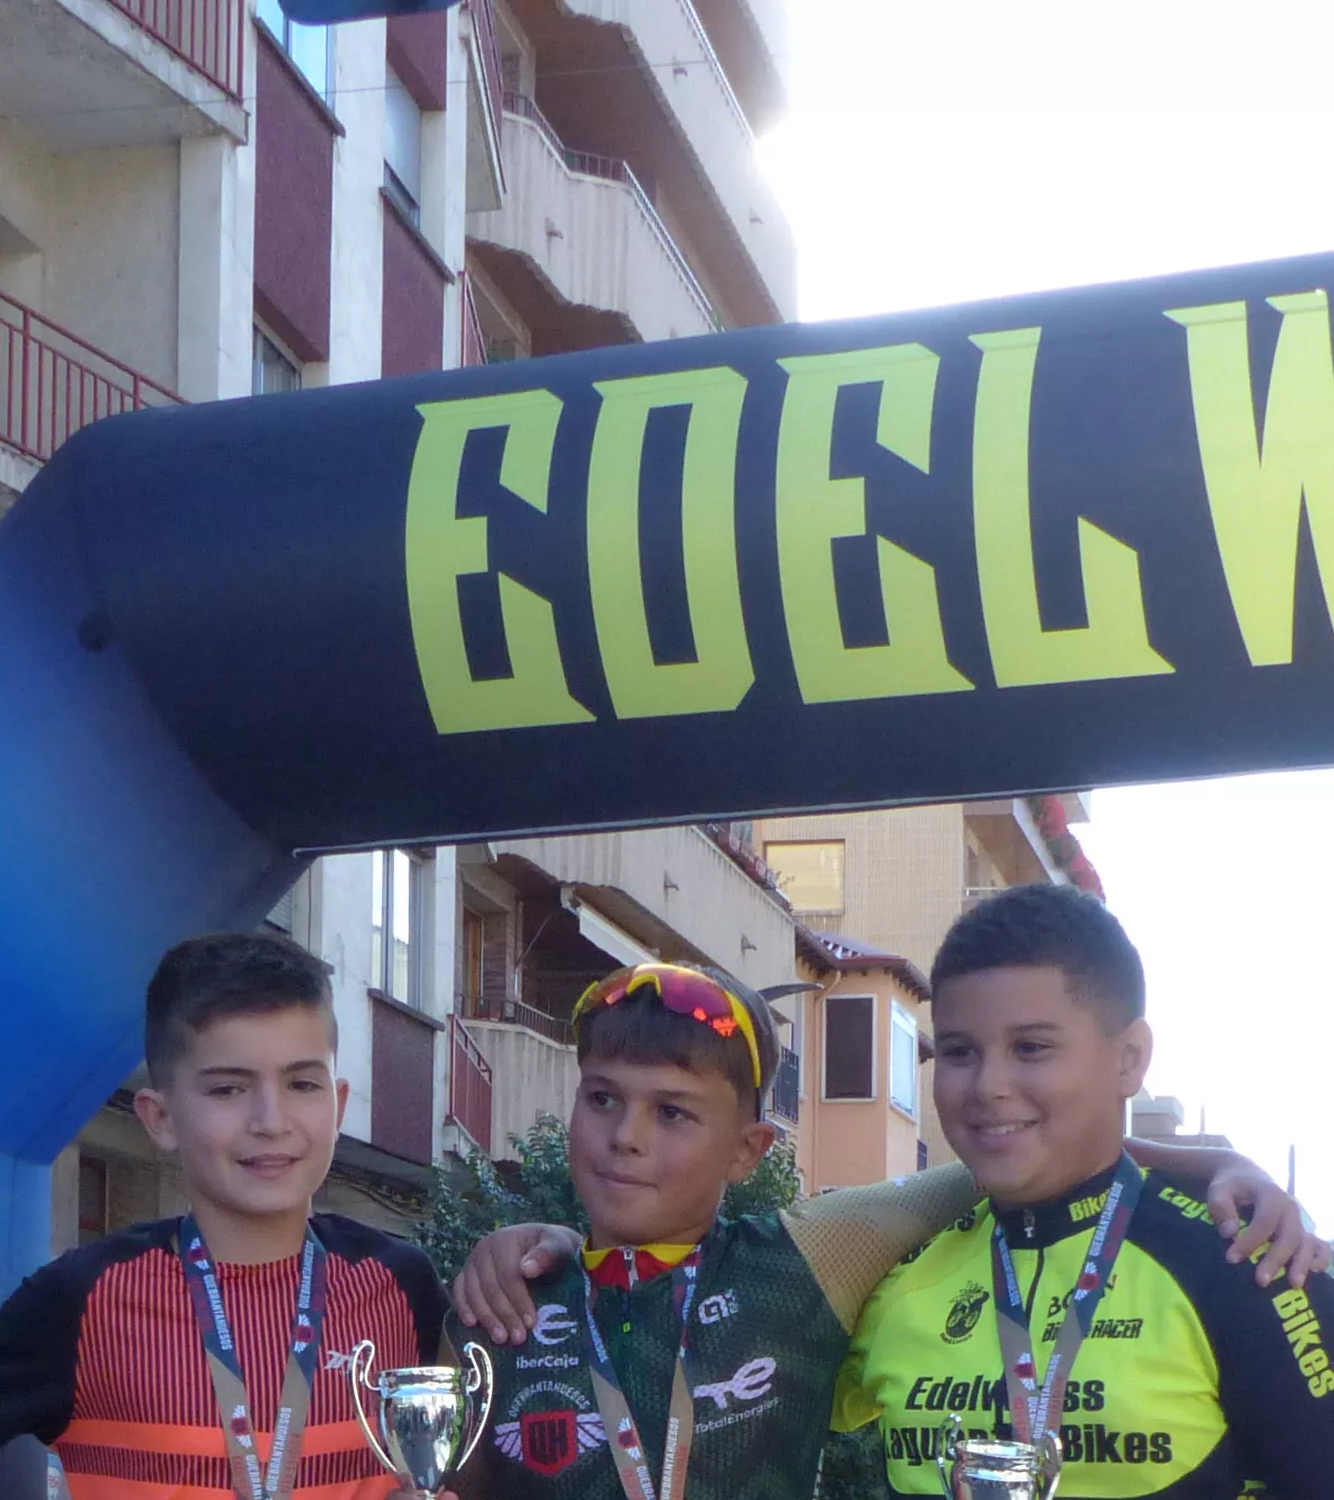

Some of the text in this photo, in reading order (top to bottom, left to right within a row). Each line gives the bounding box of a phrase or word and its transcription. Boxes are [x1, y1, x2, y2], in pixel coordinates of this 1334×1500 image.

[203, 1273, 234, 1350] QUEBRANTAHUESOS
[695, 1397, 780, 1434] TotalEnergies
[1063, 1424, 1174, 1465] Bikes
[267, 1407, 292, 1491] QUEBRANTAHUESOS
